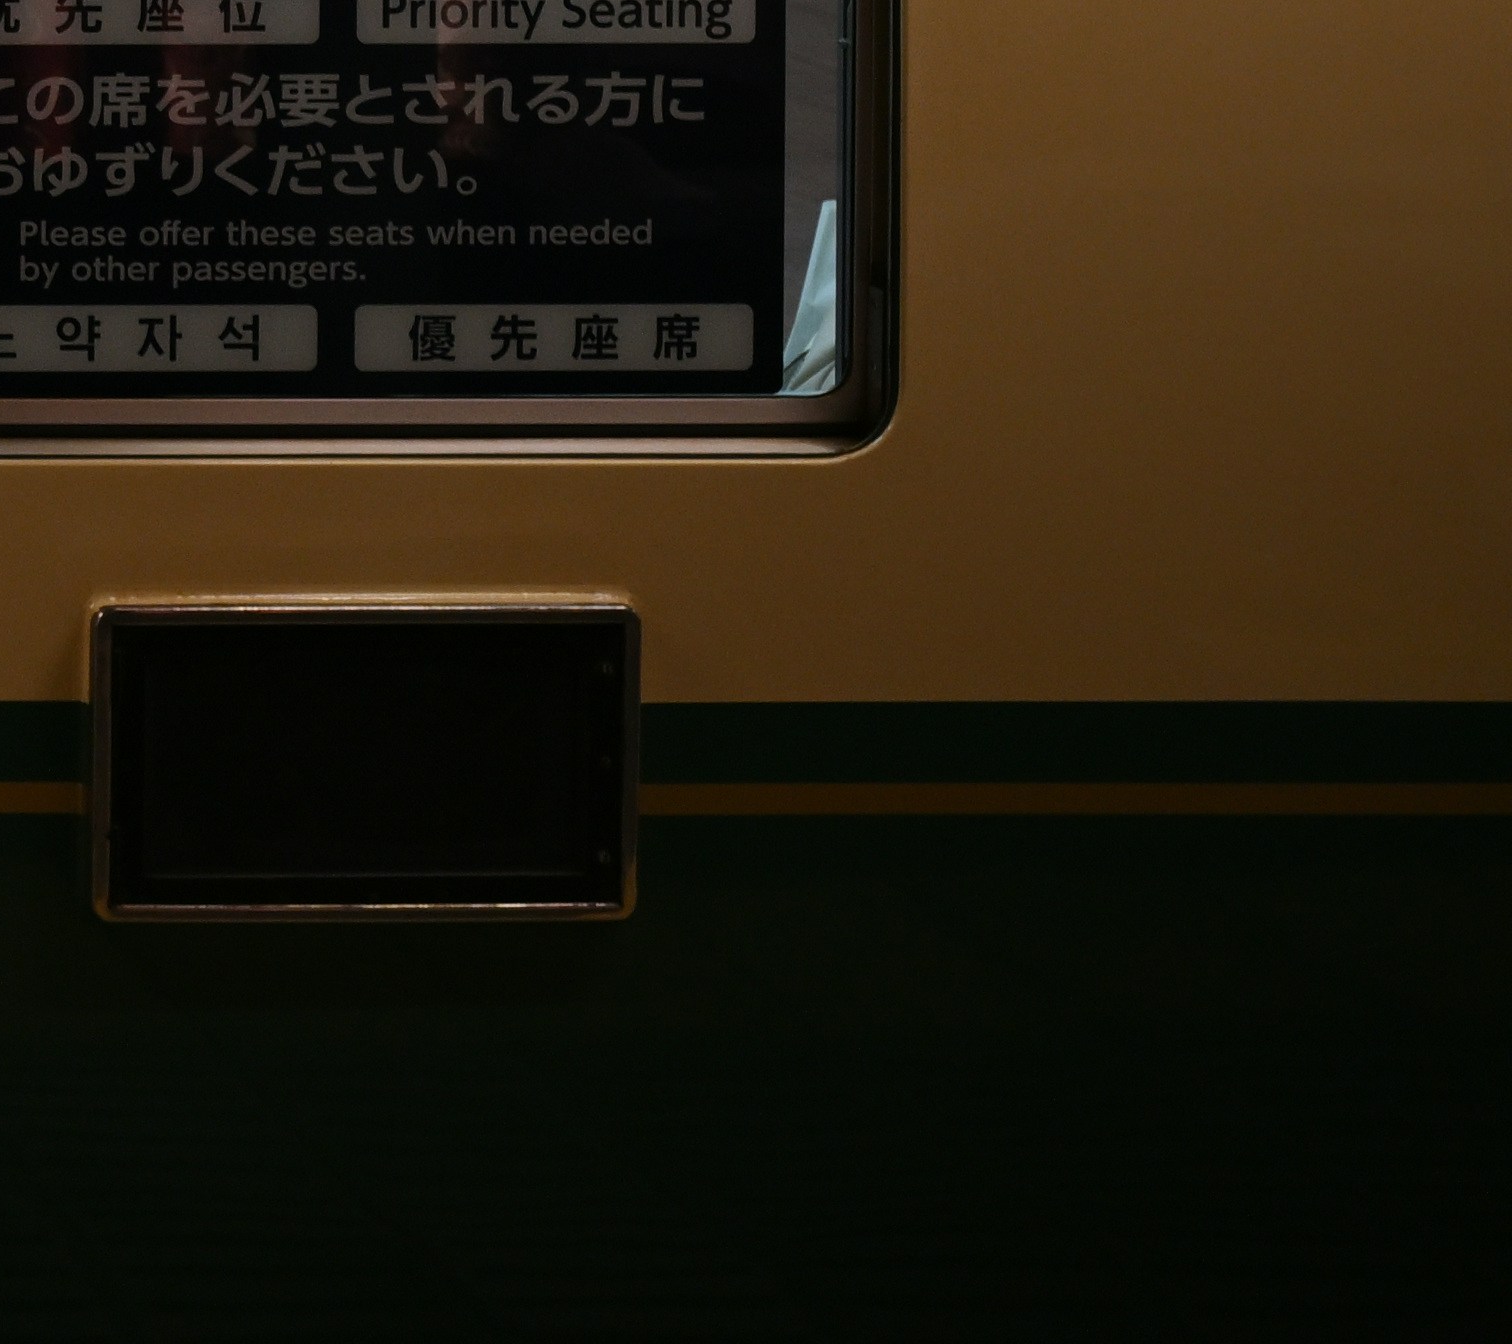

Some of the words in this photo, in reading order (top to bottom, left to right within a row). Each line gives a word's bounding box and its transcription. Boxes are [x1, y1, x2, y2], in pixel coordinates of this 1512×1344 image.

[19, 219, 128, 249] Please
[137, 219, 217, 249] offer
[226, 219, 318, 249] these
[327, 221, 415, 249] seats
[426, 219, 517, 249] when
[528, 219, 654, 249] needed
[19, 255, 58, 288] by
[70, 255, 161, 285] other
[170, 258, 368, 290] passengers.
[407, 313, 702, 364] 優先座席
